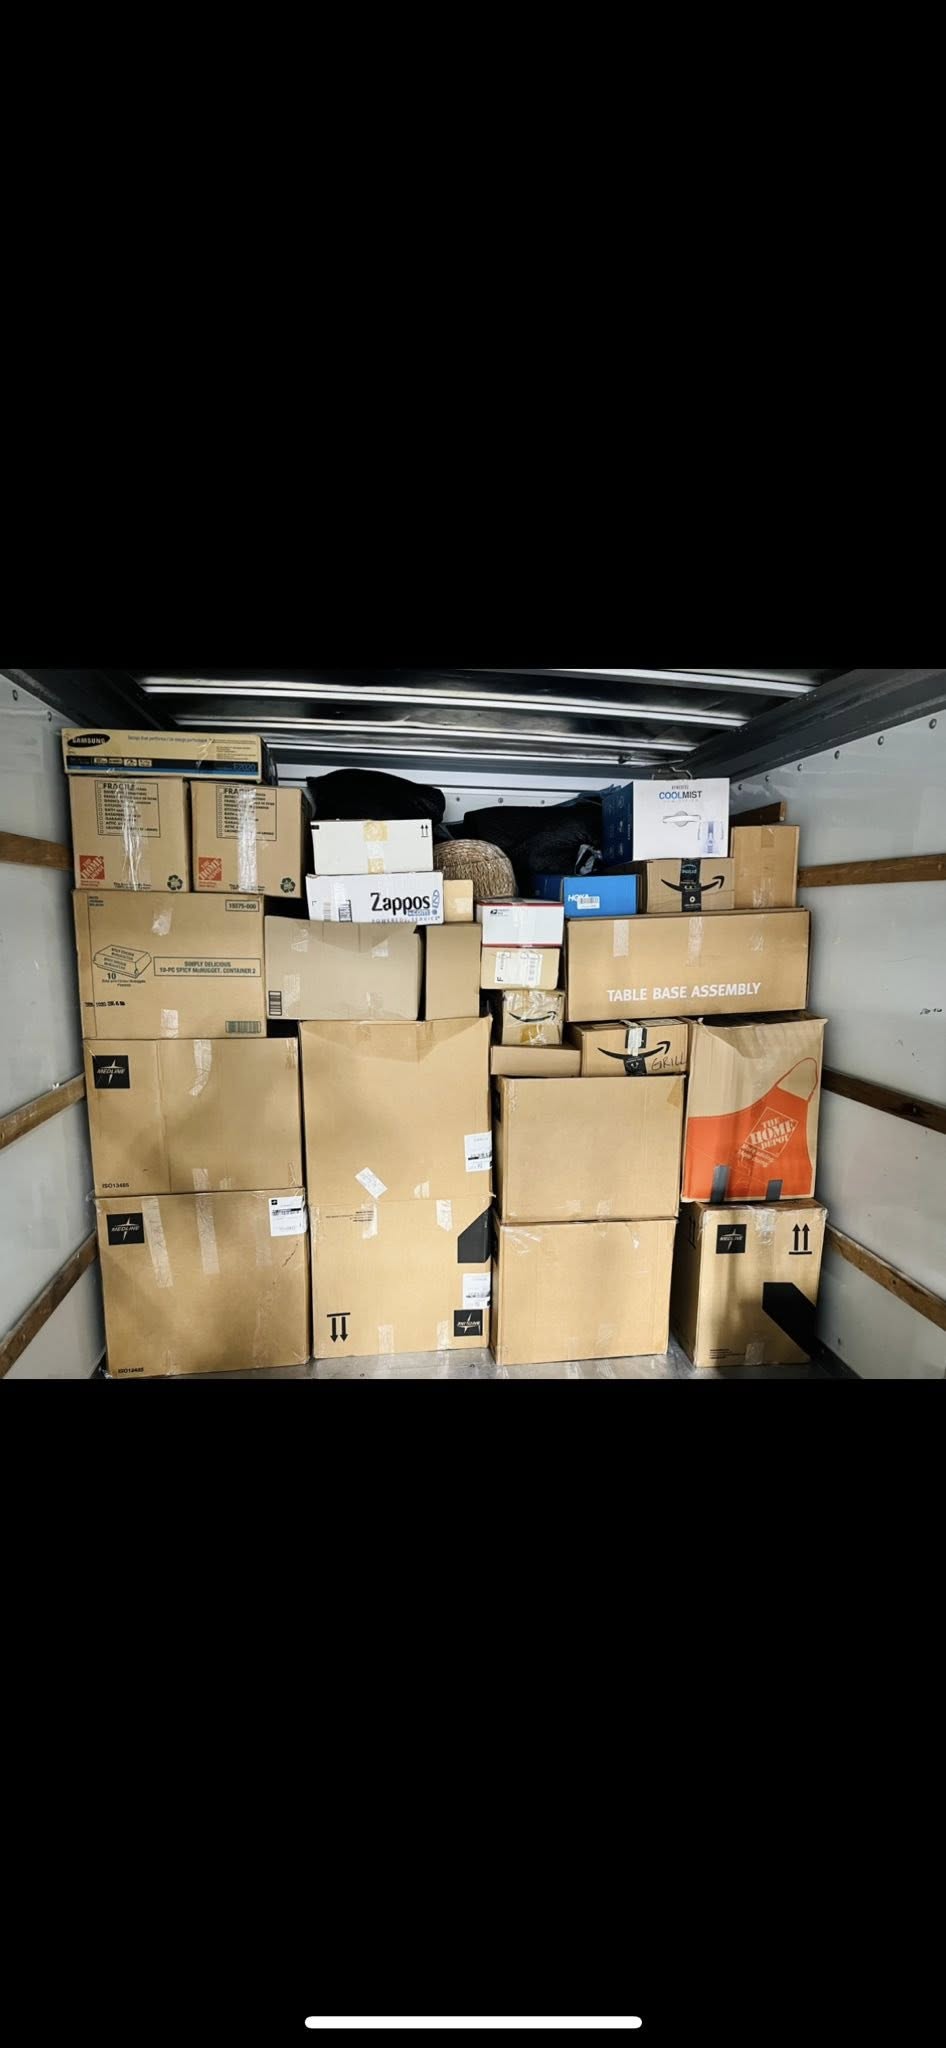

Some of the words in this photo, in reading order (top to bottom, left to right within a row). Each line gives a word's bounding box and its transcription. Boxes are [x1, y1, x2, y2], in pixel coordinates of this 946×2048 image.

[659, 790, 702, 800] COOLMIST
[80, 855, 103, 879] HOME
[199, 858, 221, 880] HOME
[370, 892, 430, 915] Zappos
[607, 987, 648, 1002] TABLE
[653, 985, 688, 1000] BASE
[691, 982, 762, 998] ASSEMBLY
[651, 1051, 688, 1071] GRILL
[750, 1119, 795, 1145] HOME
[761, 1117, 779, 1129] THE
[761, 1134, 790, 1150] DEPOT
